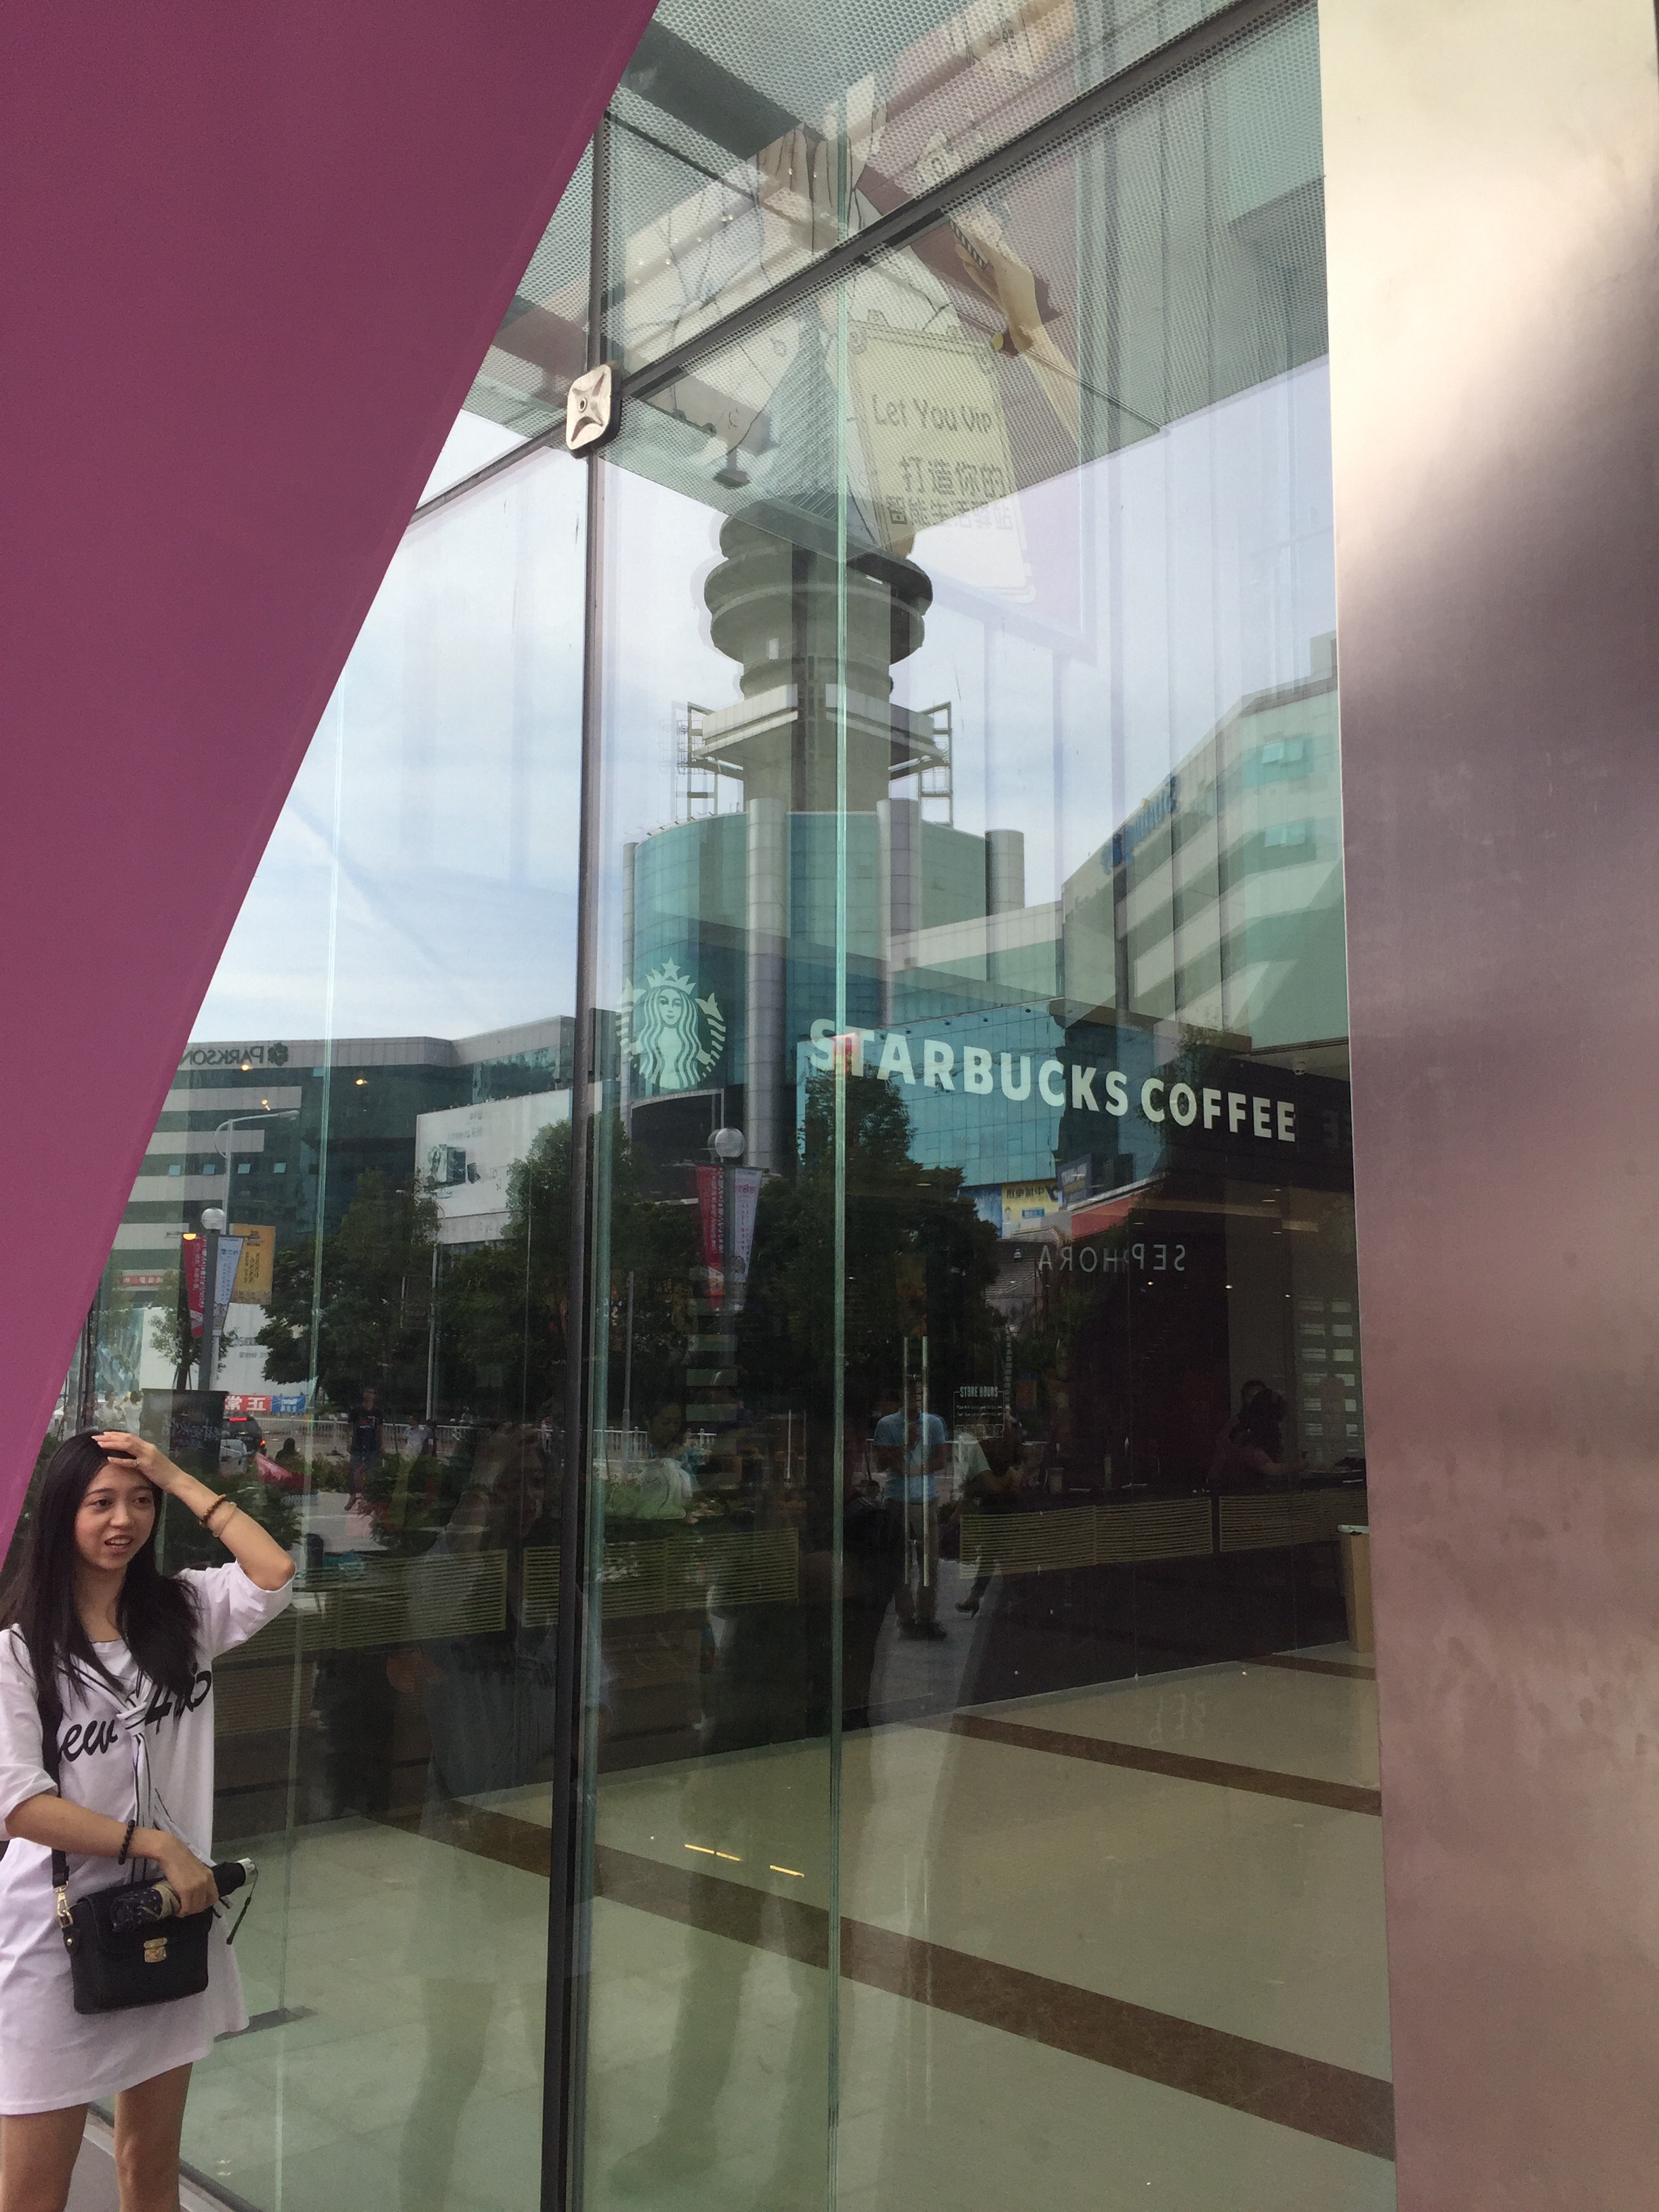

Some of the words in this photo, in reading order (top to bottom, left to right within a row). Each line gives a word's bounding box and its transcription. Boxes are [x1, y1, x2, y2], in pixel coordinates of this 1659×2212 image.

[872, 393, 909, 428] Let
[913, 397, 958, 432] You
[899, 456, 1006, 498] 打造你的
[810, 1019, 1129, 1116] STARBUCKS
[1141, 1078, 1296, 1143] COFFEE
[960, 1386, 978, 1397] STORE
[59, 1719, 119, 1762] ew
